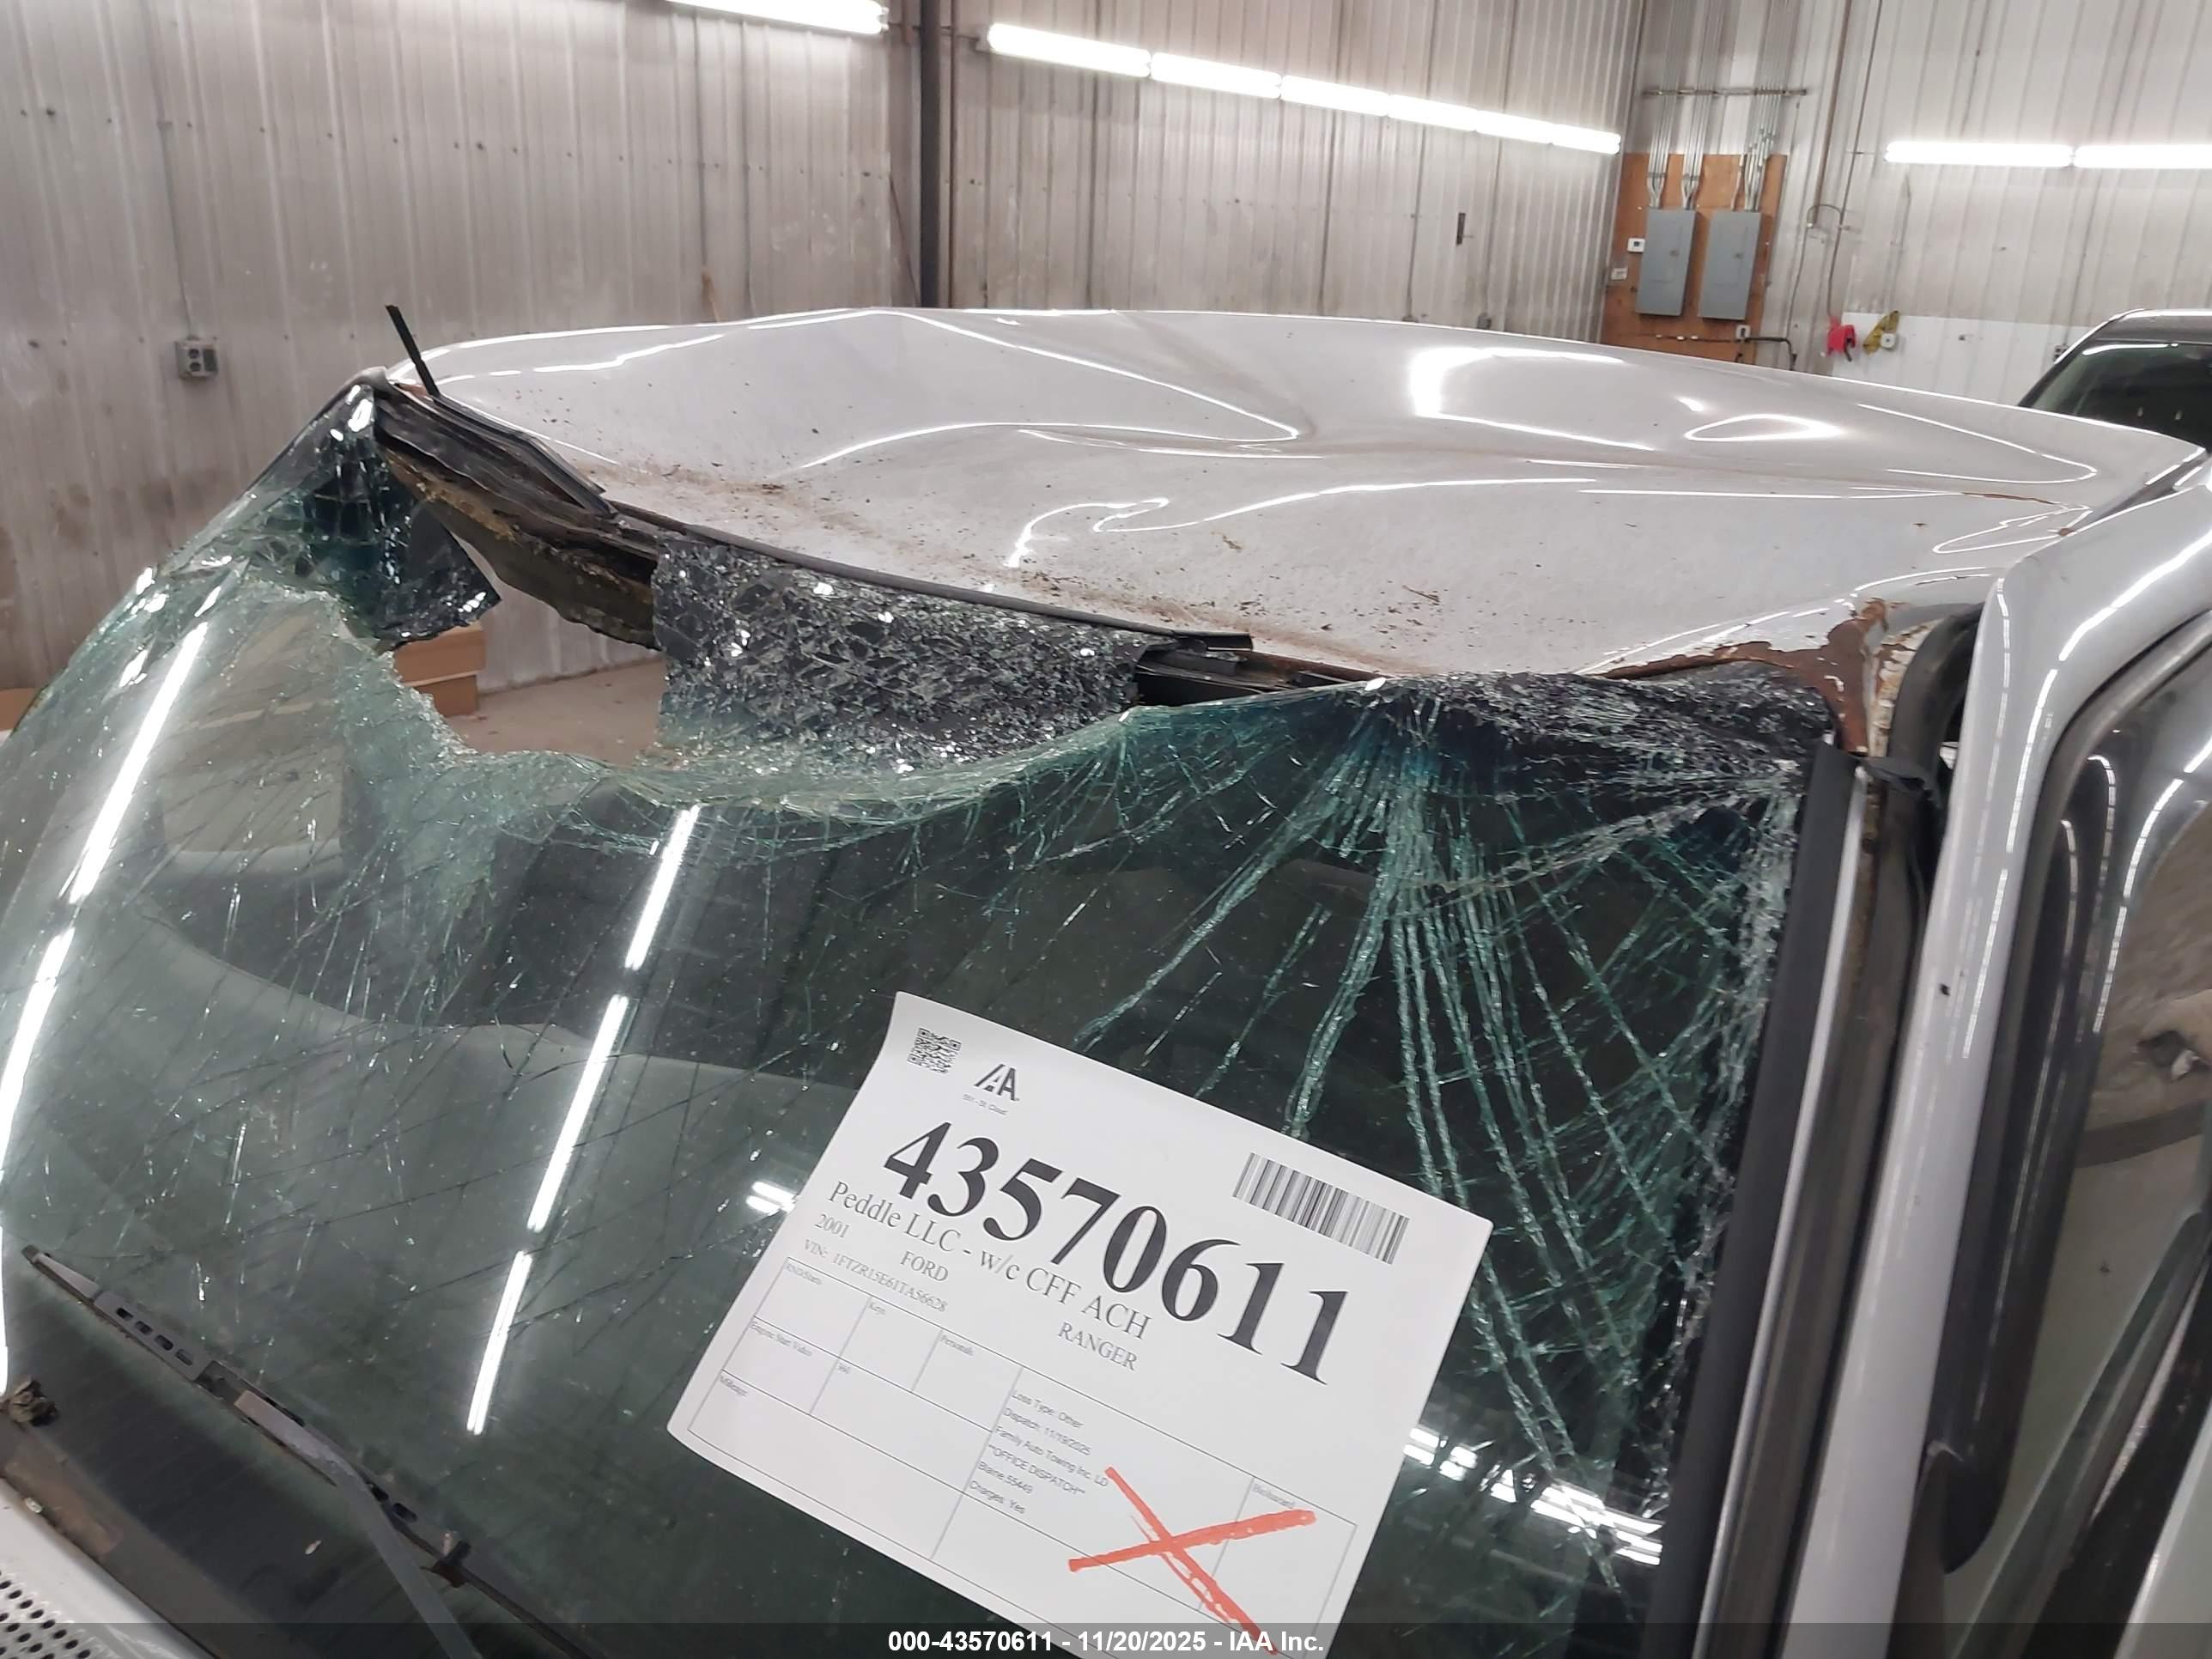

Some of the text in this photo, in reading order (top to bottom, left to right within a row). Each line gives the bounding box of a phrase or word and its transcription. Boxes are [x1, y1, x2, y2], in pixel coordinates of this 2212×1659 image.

[814, 1213, 850, 1238] 2001
[805, 1239, 828, 1258] VIN:
[828, 1181, 901, 1228] Peddle
[903, 1213, 961, 1253] LLC
[1026, 1267, 1081, 1305] CFF
[1081, 1295, 1152, 1340] ACH
[884, 1121, 1349, 1386] 43570611
[900, 1250, 949, 1282] FORD
[1058, 1322, 1138, 1370] RANGER
[1024, 1440, 1044, 1455] Auto
[1044, 1449, 1077, 1474] Towing
